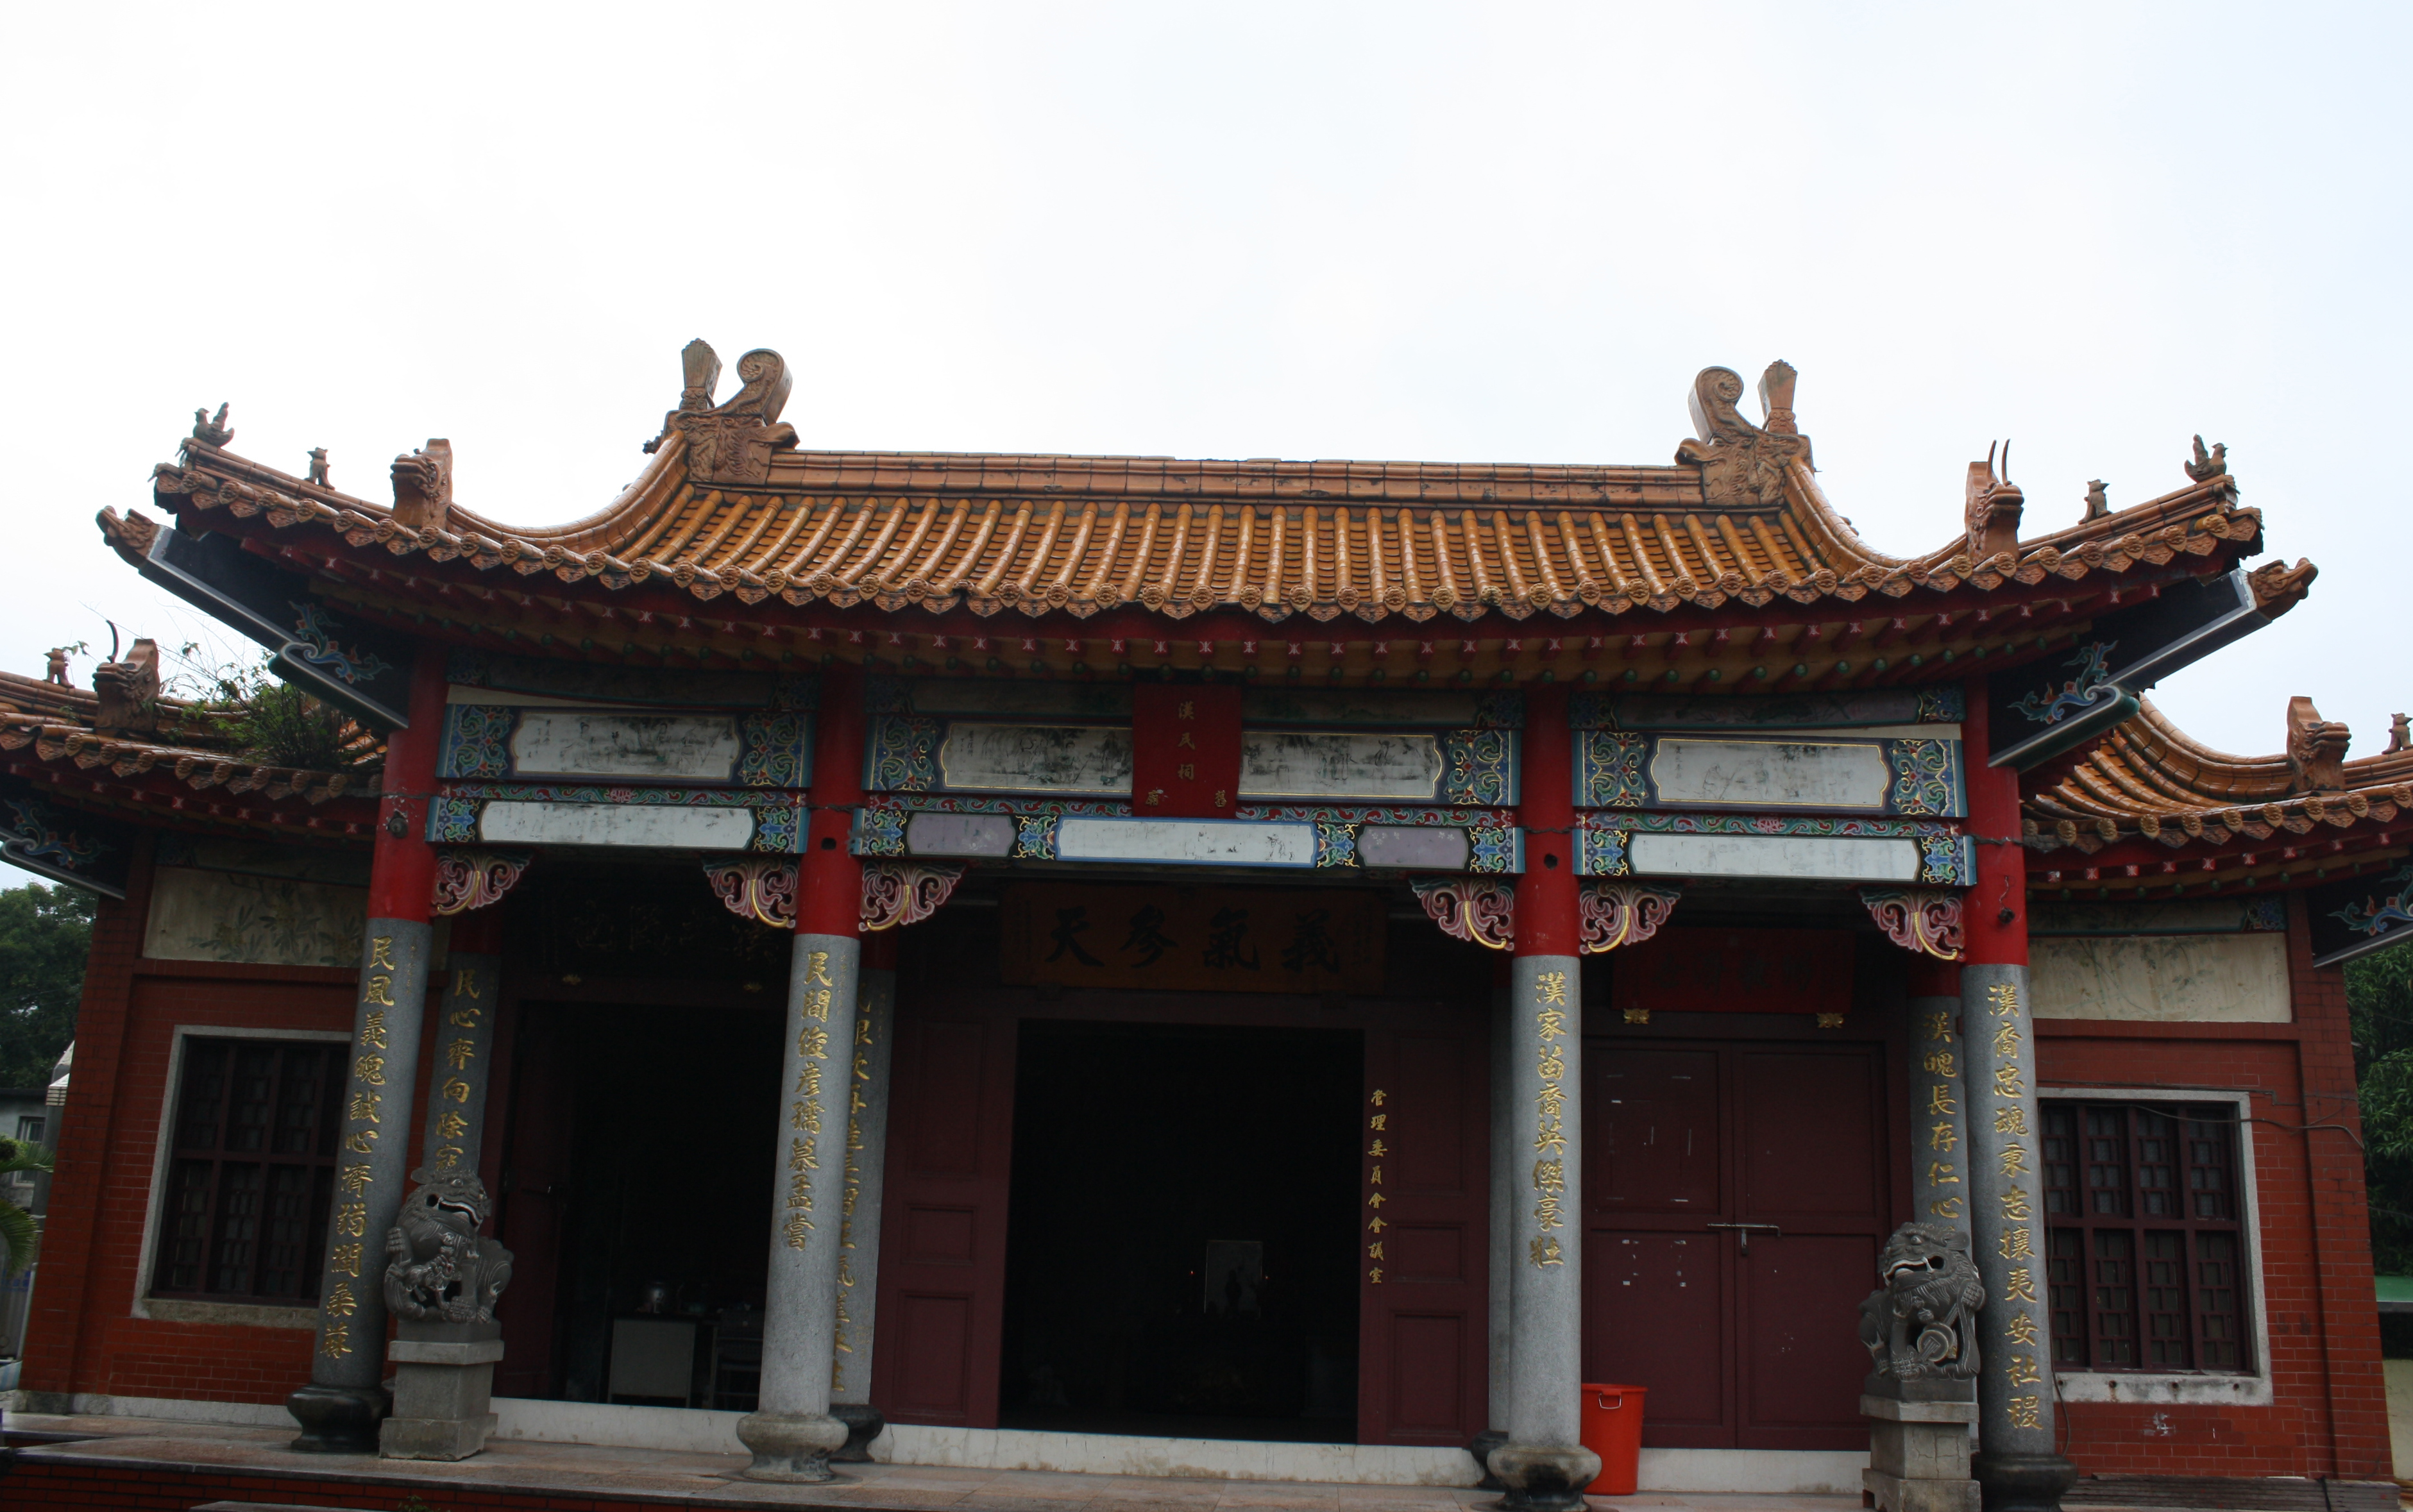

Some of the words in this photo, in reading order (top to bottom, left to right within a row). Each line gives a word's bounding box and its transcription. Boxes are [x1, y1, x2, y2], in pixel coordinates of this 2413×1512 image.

[1178, 700, 1196, 781] 漢民祠
[1044, 903, 1341, 973] 義氣參天
[1367, 1088, 1388, 1284] 管理委員會會議室
[1528, 970, 1567, 1269] 漢家苗裔英傑豪壯
[1923, 1011, 1963, 1231] 漢魄長存仁心
[1986, 982, 2044, 1430] 漢裔忠魂秉志攘夷安社稷
